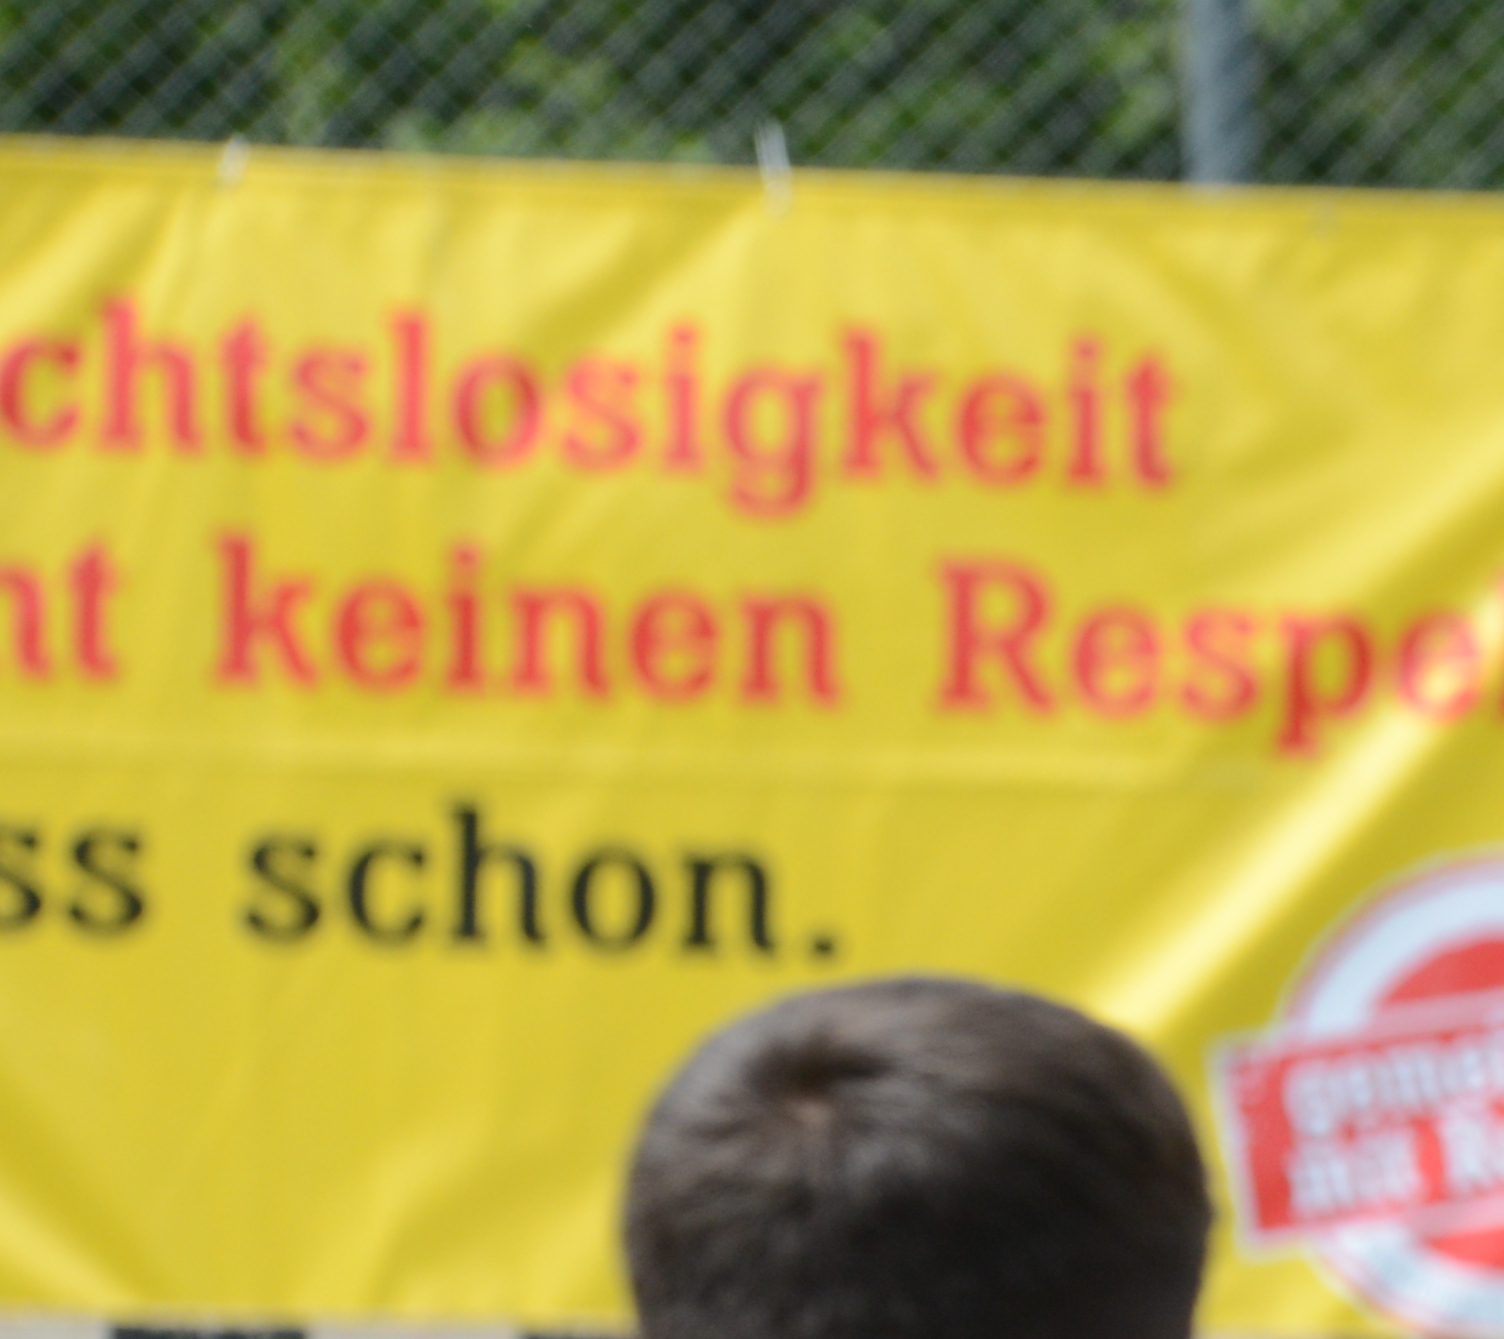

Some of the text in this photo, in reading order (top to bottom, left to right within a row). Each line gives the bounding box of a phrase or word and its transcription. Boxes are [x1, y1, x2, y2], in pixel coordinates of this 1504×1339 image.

[0, 292, 1176, 517] chtslosigkeit
[212, 532, 842, 706] keinen
[243, 800, 843, 960] schon.
